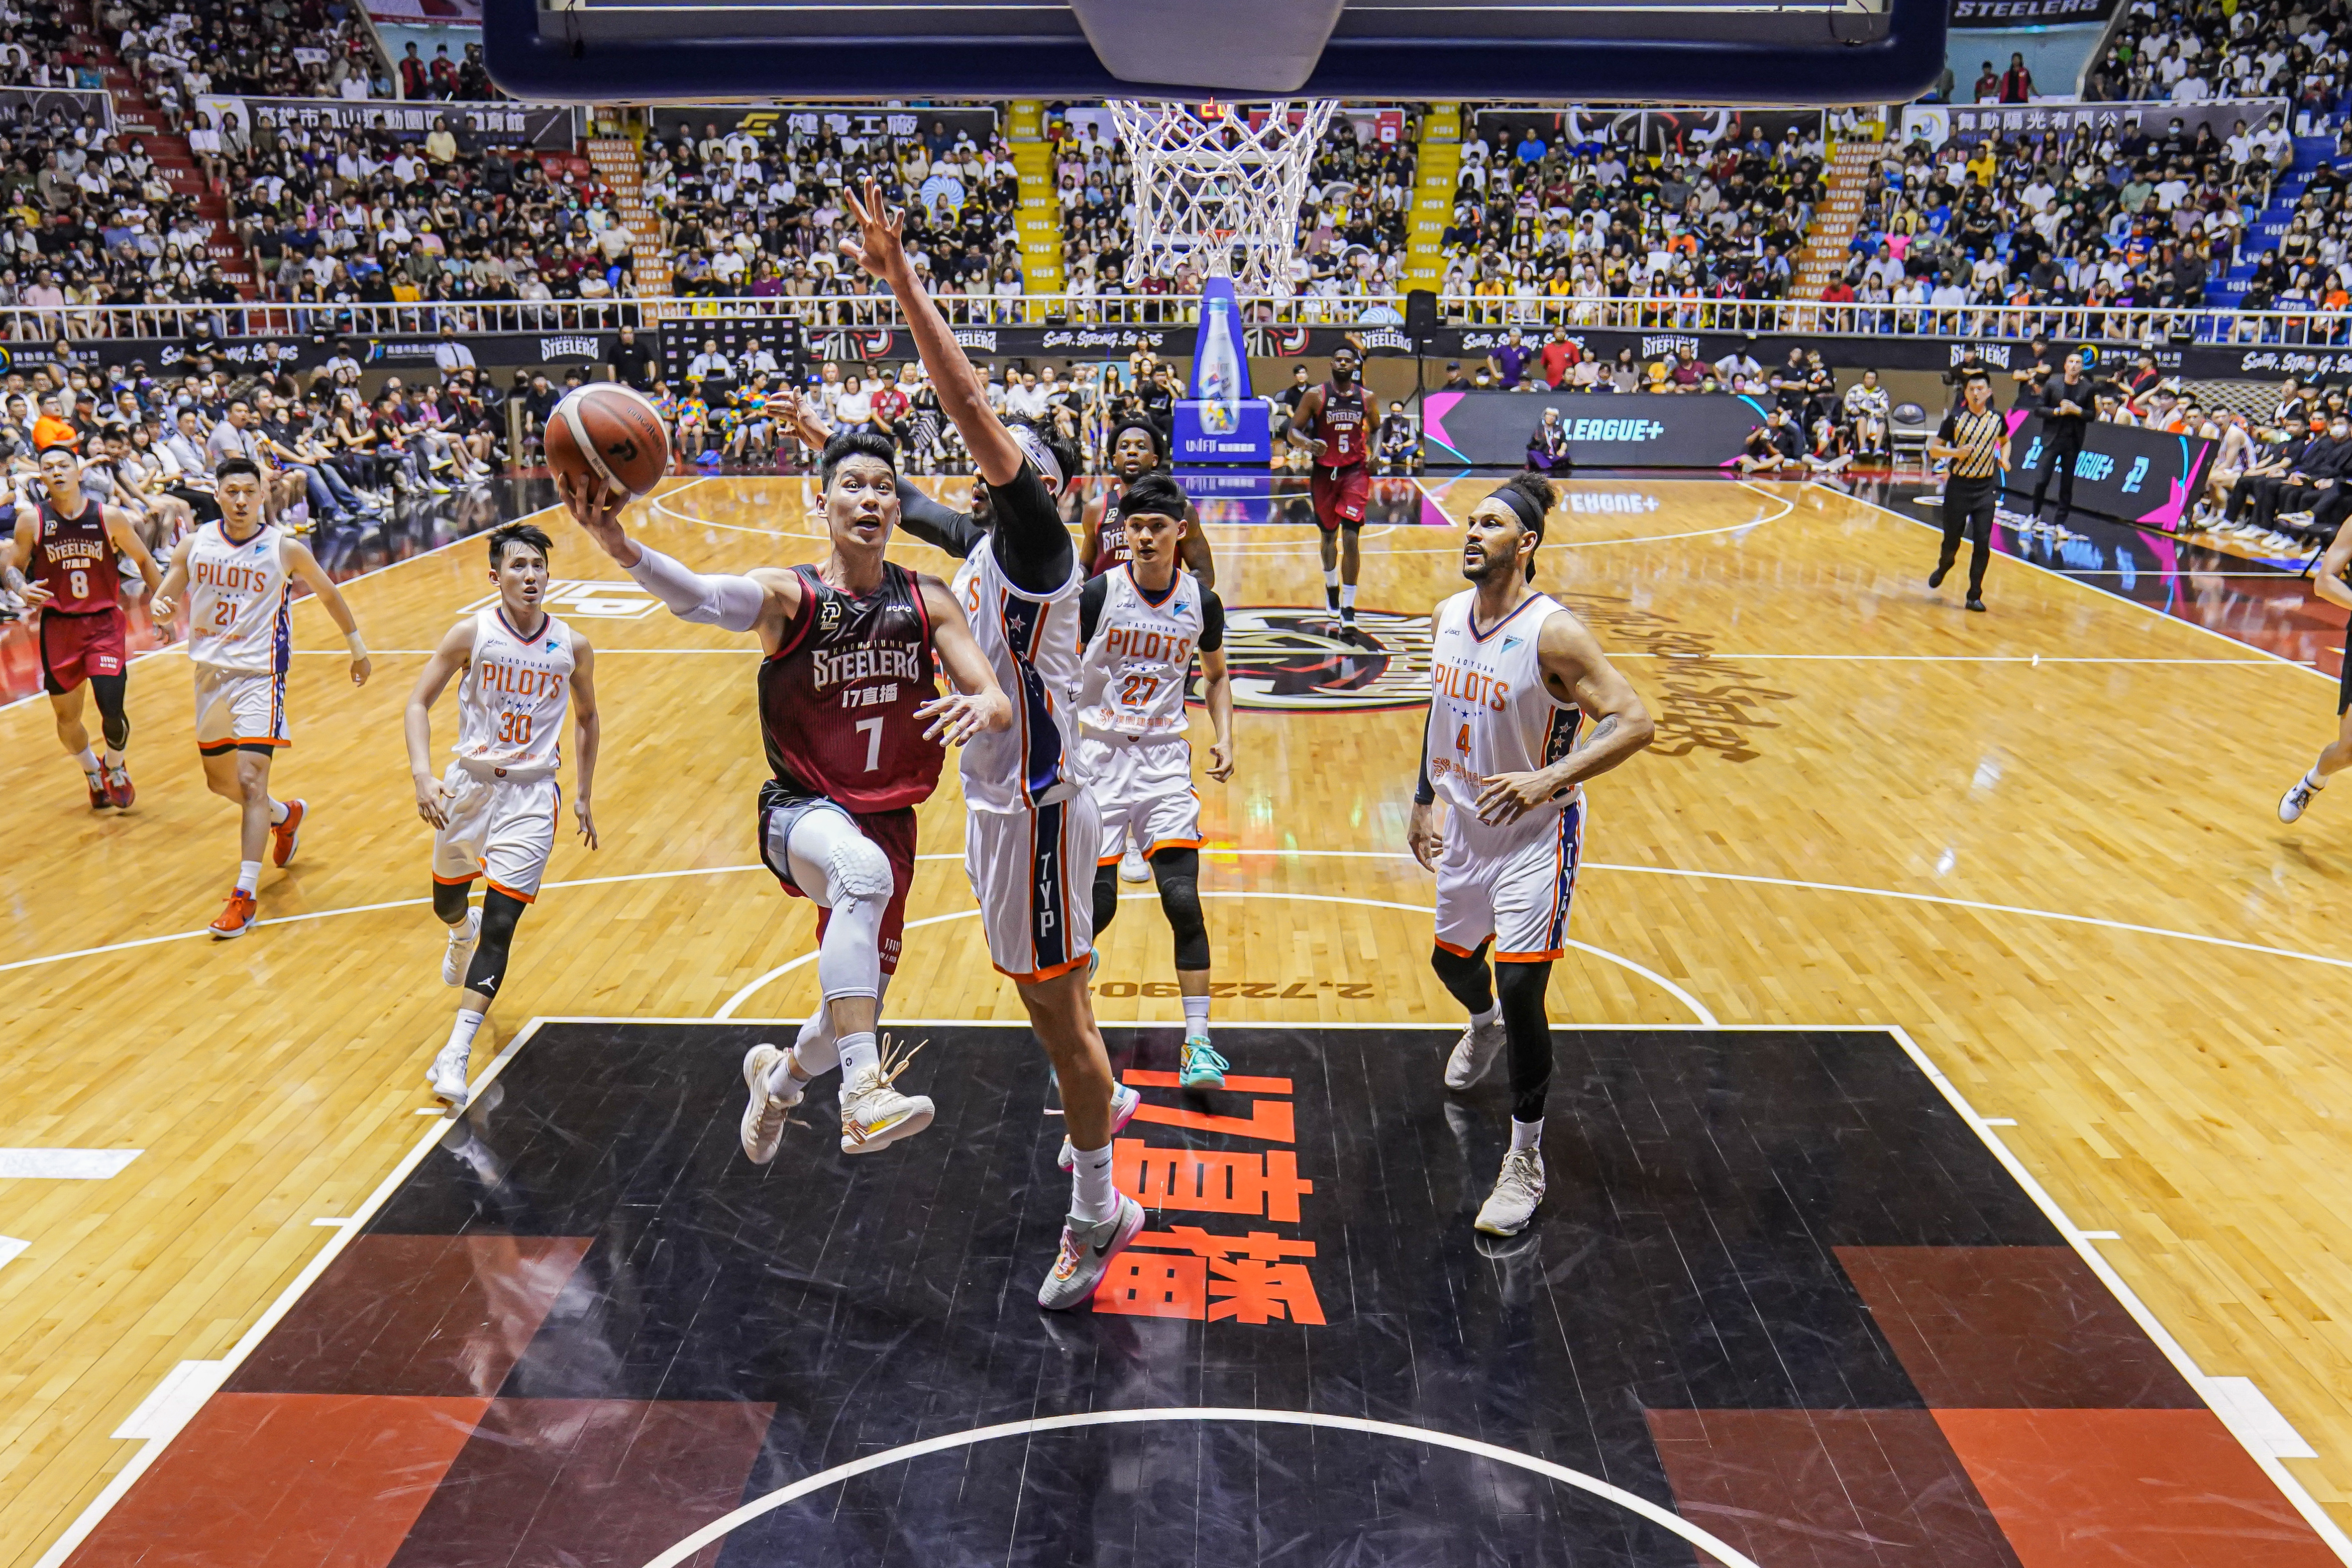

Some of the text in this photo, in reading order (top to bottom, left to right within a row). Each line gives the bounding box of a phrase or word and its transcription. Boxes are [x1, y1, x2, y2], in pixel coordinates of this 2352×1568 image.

[540, 337, 599, 362] STEELERS
[1338, 434, 1350, 453] 5
[1562, 418, 1664, 441] LEAGUE+
[44, 540, 104, 564] STEELERS
[71, 570, 90, 600] 8
[197, 563, 267, 593] PILOTS
[215, 602, 238, 626] 21
[1127, 622, 1176, 633] TAOYUAN
[833, 639, 903, 655] KAOHSIUNG
[1105, 628, 1191, 663] PILOTS
[1506, 634, 1524, 642] DAIKIN
[501, 656, 551, 669] TAOYUAN
[810, 641, 922, 692] STEELERS
[1451, 656, 1495, 674] TAOYUAN
[481, 663, 563, 699] PILOTS
[1121, 675, 1159, 707] 27
[1435, 662, 1510, 713] PILOTS
[842, 682, 898, 709] 17直播
[498, 712, 533, 744] 30
[1455, 724, 1472, 758] 4
[855, 717, 883, 773] 7
[1039, 851, 1055, 938] TYP
